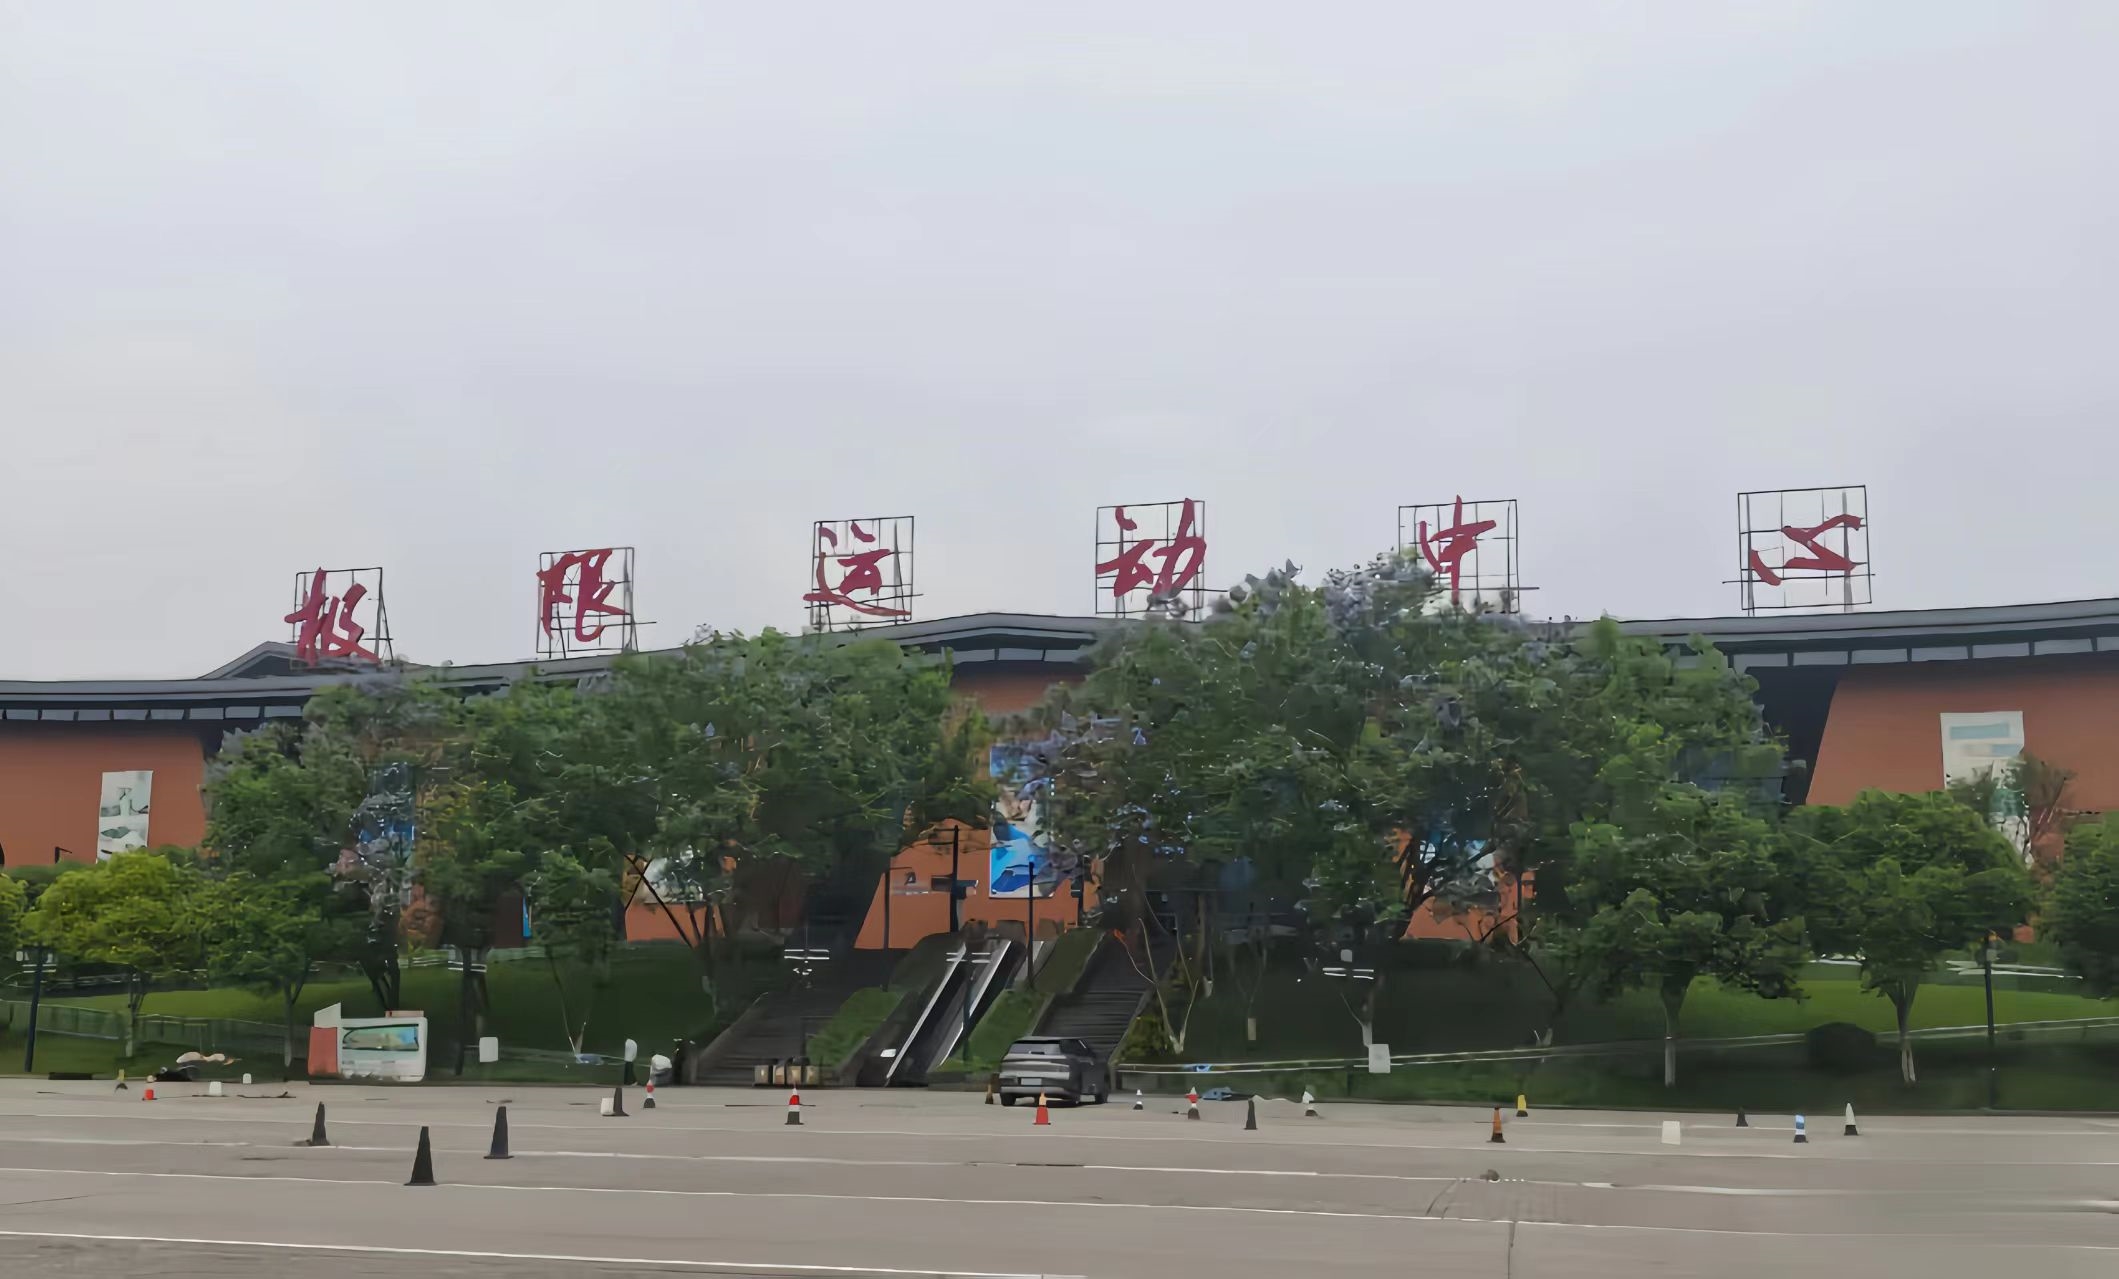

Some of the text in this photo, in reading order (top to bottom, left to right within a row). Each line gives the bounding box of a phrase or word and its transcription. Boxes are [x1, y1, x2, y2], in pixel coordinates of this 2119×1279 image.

[284, 495, 1865, 665] 极限运动中心
